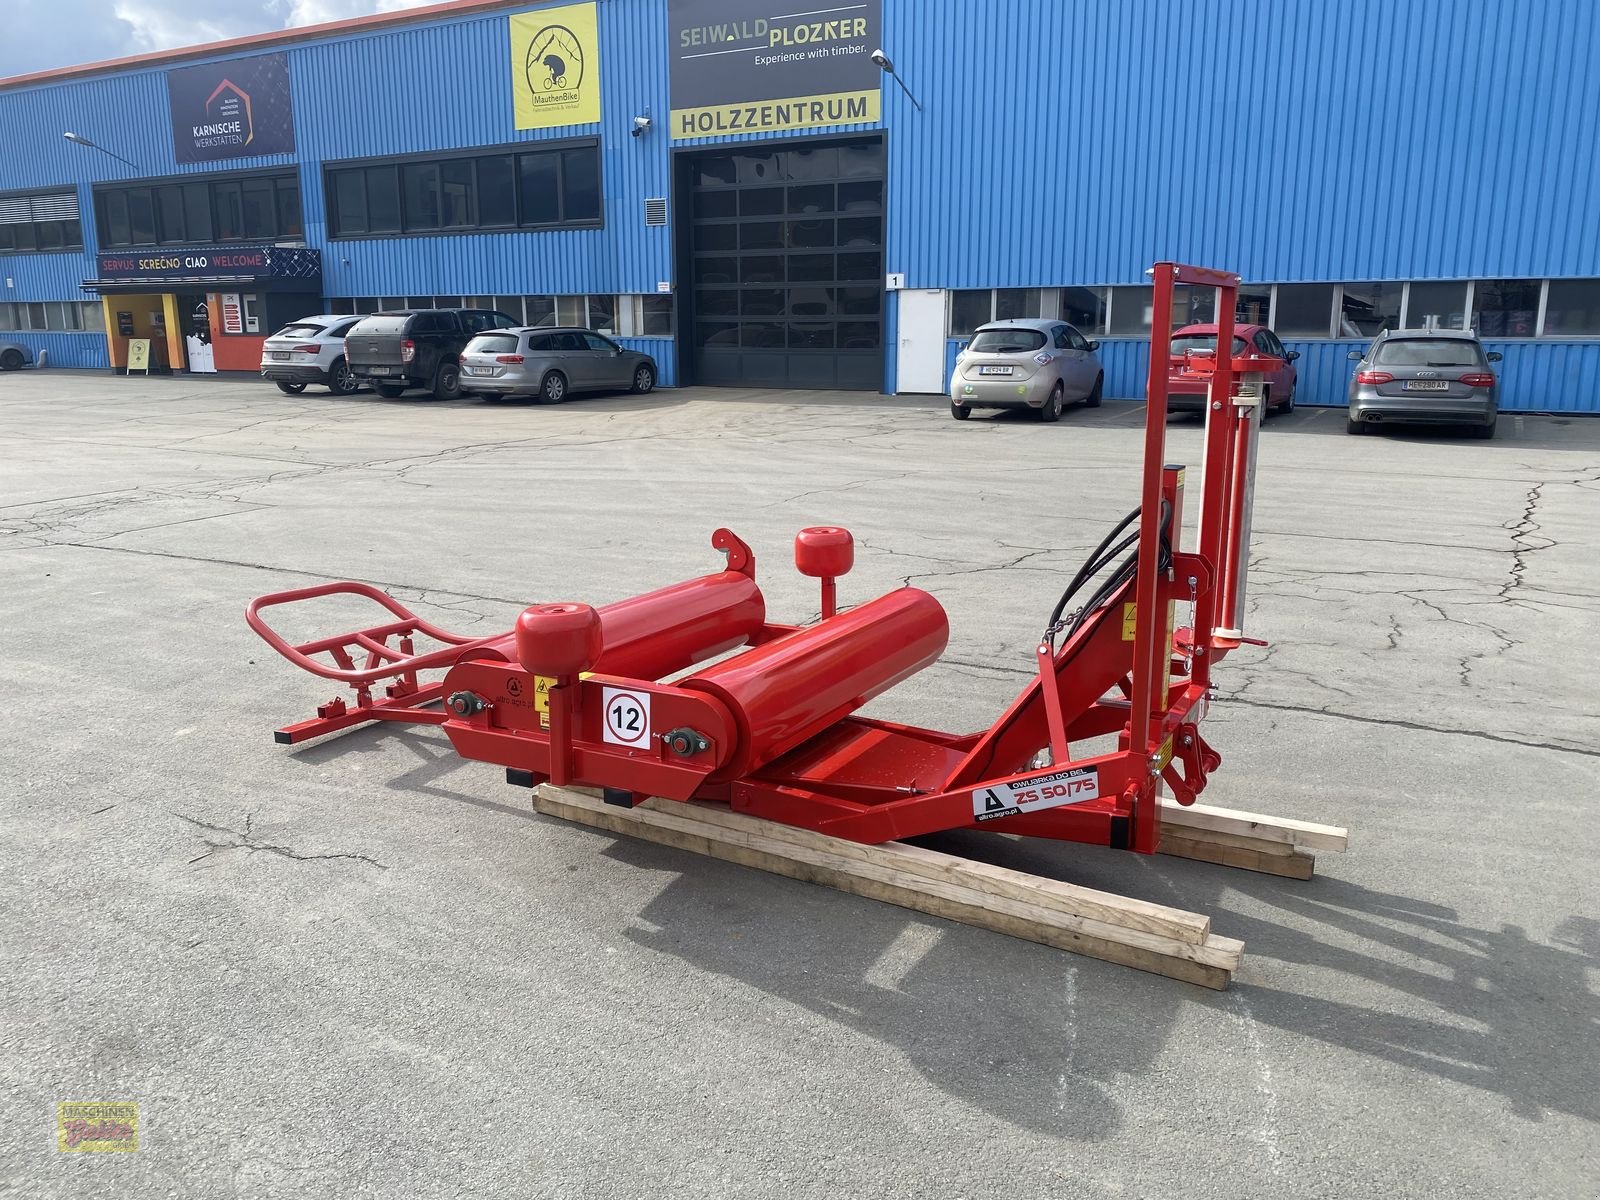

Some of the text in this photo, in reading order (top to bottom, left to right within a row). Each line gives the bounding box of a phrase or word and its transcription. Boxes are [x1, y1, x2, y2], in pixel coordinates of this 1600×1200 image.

[680, 18, 768, 48] SEIWALD
[754, 44, 867, 66] Experience with timber.
[534, 91, 578, 104] MauthenBike
[682, 96, 867, 134] HOLZZENTRUM
[192, 121, 241, 137] KARNISCHE
[103, 254, 262, 271] SERVUS SCREČNO CIAO WELCOME
[893, 276, 898, 286] 1
[612, 705, 640, 732] 12
[1055, 771, 1069, 780] DO
[1070, 768, 1087, 778] BEL
[1014, 778, 1096, 805] ZS 50/75
